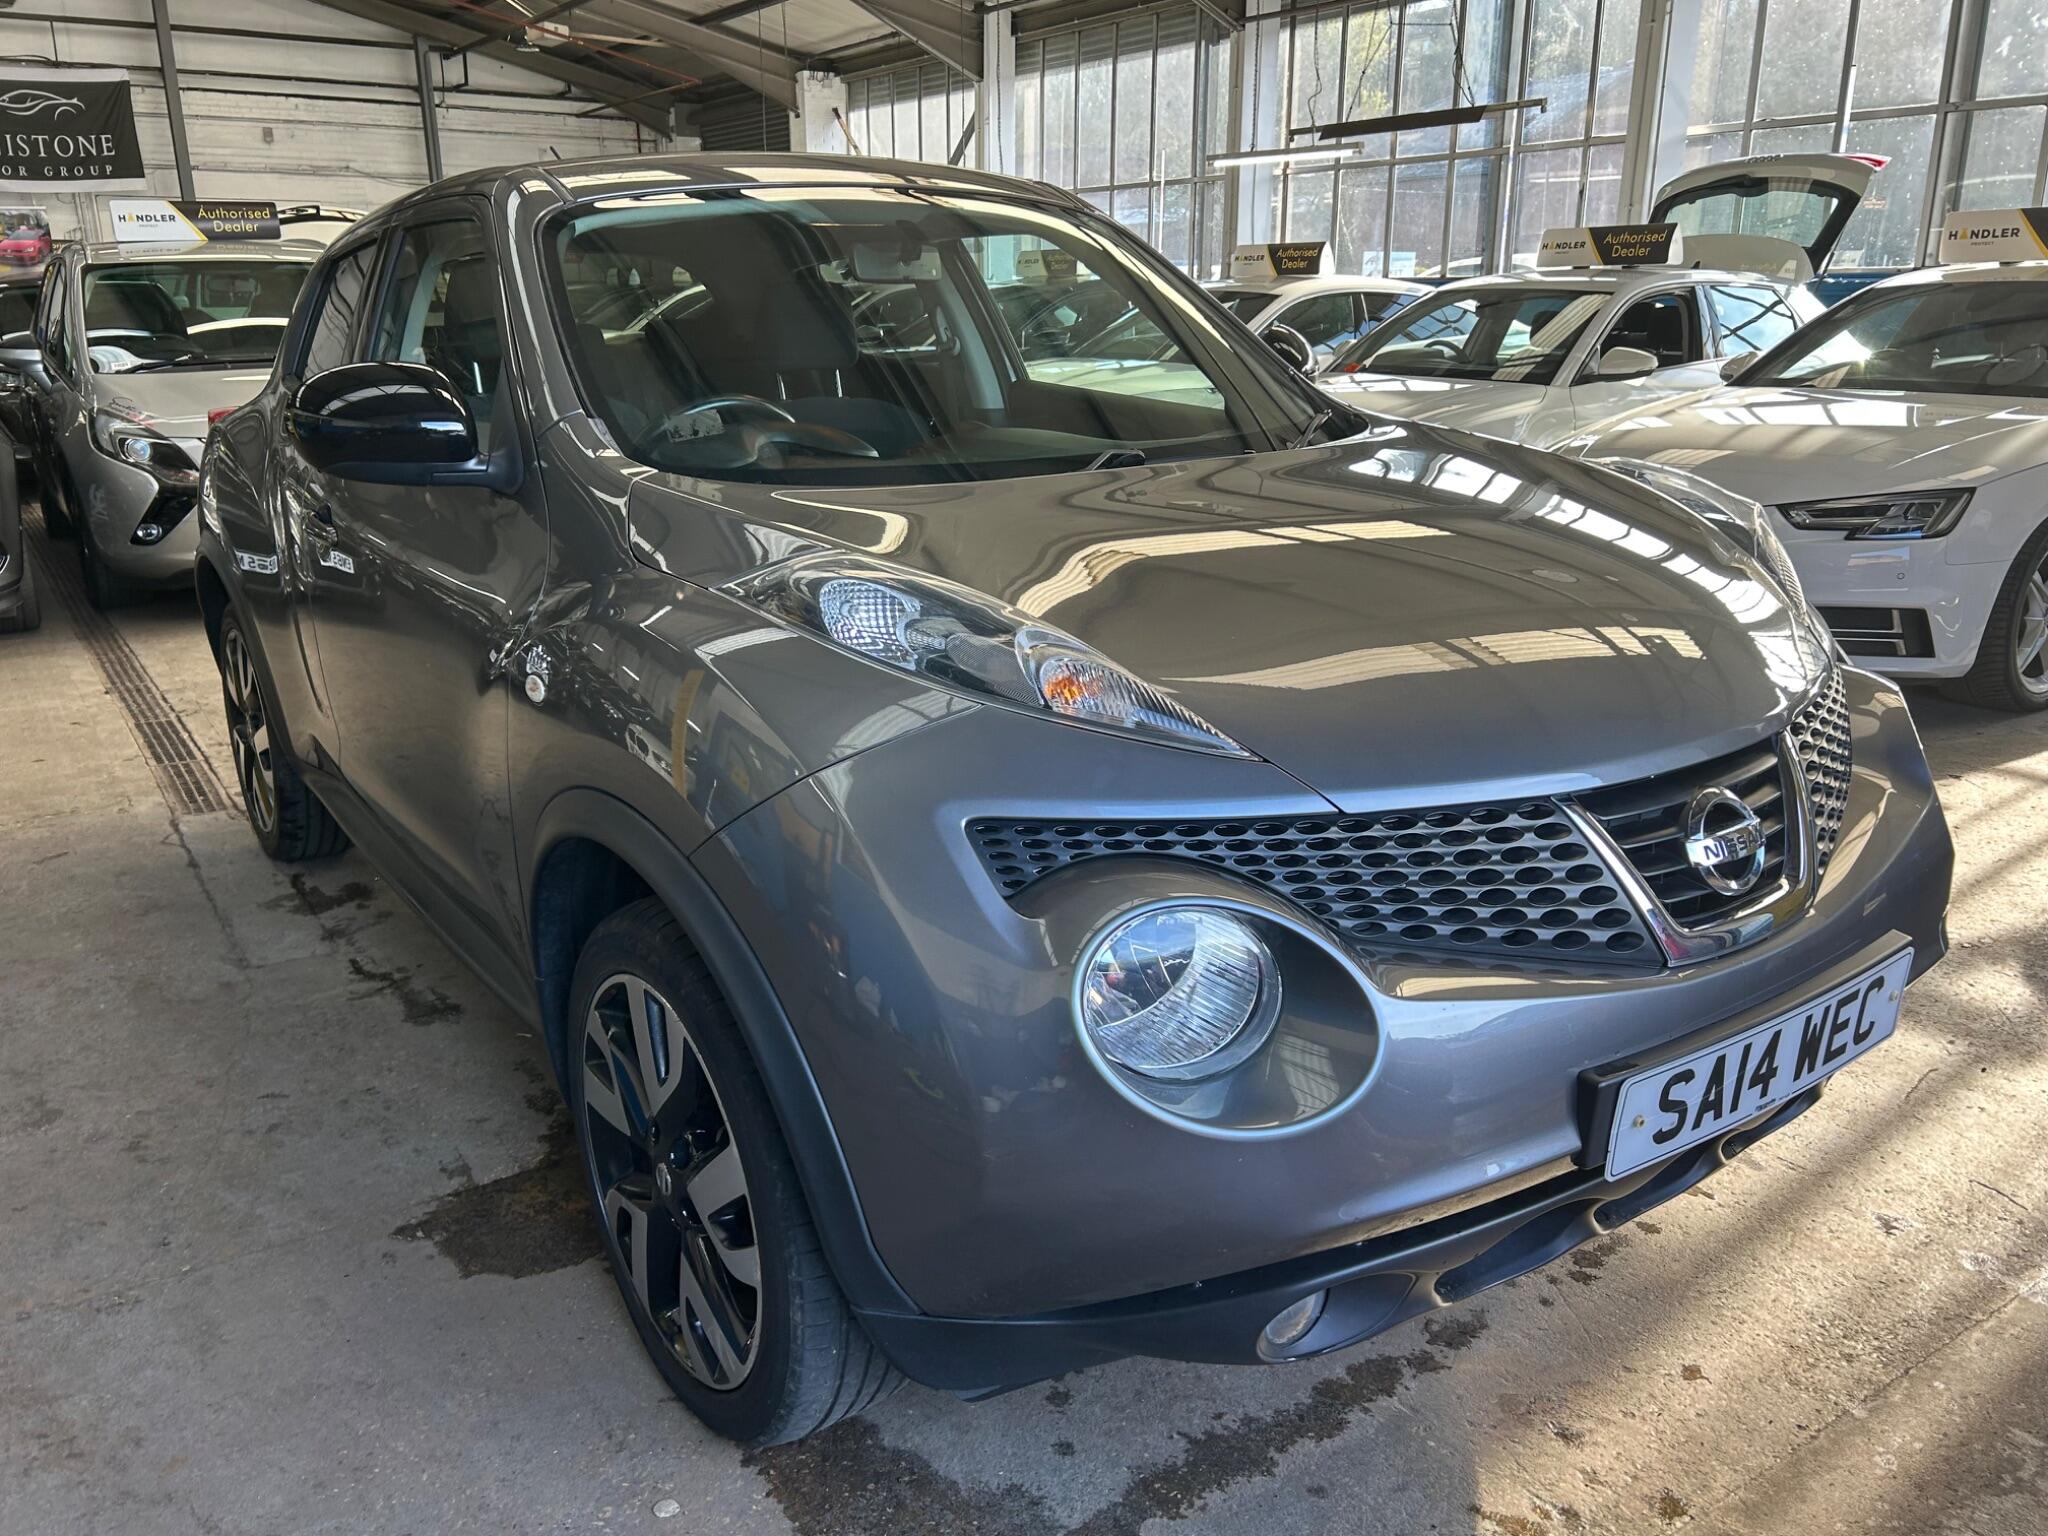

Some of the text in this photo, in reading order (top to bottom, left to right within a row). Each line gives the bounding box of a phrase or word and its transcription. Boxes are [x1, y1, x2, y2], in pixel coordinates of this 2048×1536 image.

[0, 134, 115, 157] ISTONE
[44, 164, 113, 177] GROUP
[118, 213, 176, 223] HANDLER
[198, 205, 270, 219] Authorised
[213, 220, 259, 233] Dealer
[1603, 229, 1668, 244] Authorised
[1948, 227, 2020, 240] HANDLER
[1542, 240, 1586, 250] HANDLER
[1611, 245, 1651, 257] Dealer
[1276, 247, 1319, 258] Authorised
[1281, 258, 1308, 269] Dealer
[1652, 975, 1885, 1145] SA14 WEC
